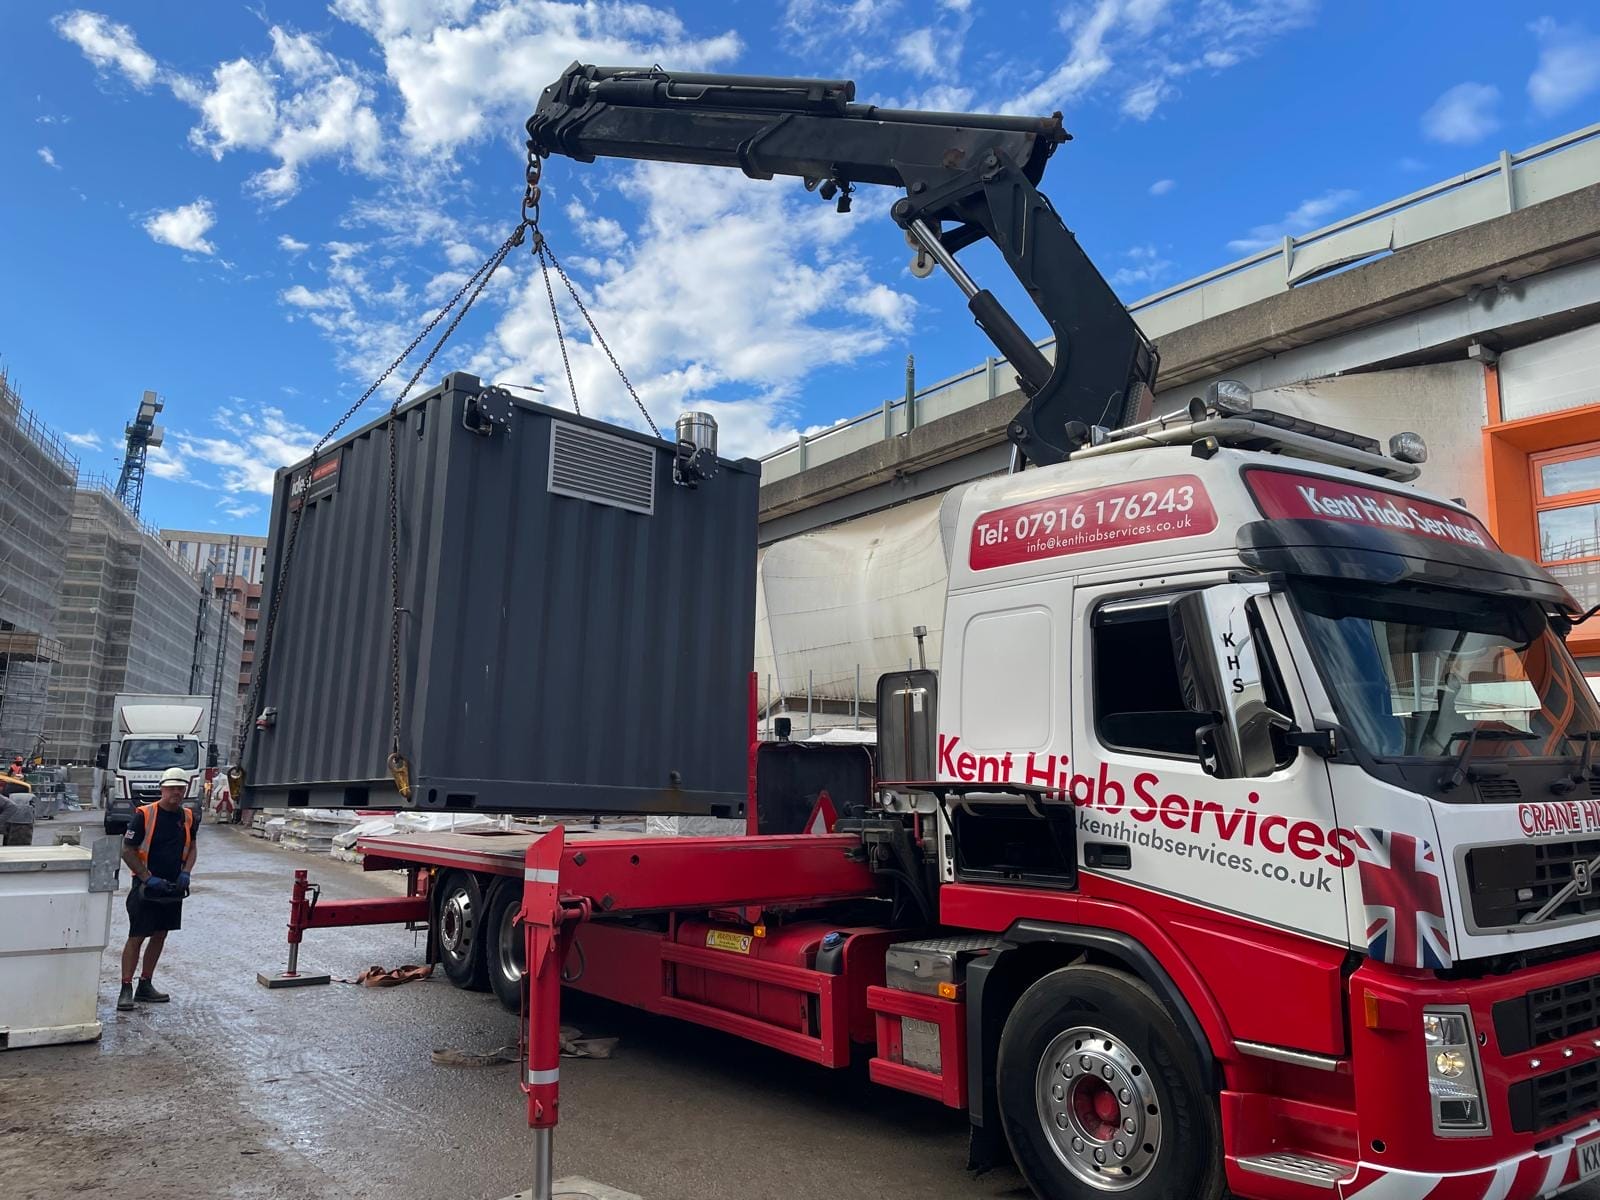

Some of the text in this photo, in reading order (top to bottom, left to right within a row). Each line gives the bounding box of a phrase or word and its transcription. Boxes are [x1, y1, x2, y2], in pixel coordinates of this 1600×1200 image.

[291, 473, 312, 497] idel
[977, 485, 1194, 546] Tel: 07916 176243
[1027, 514, 1192, 553] info@kenthiabservices.co.uk
[1297, 485, 1485, 547] Kent Hiab Services
[938, 733, 1357, 868] Kent Hiab Services
[1518, 802, 1582, 837] CRANE
